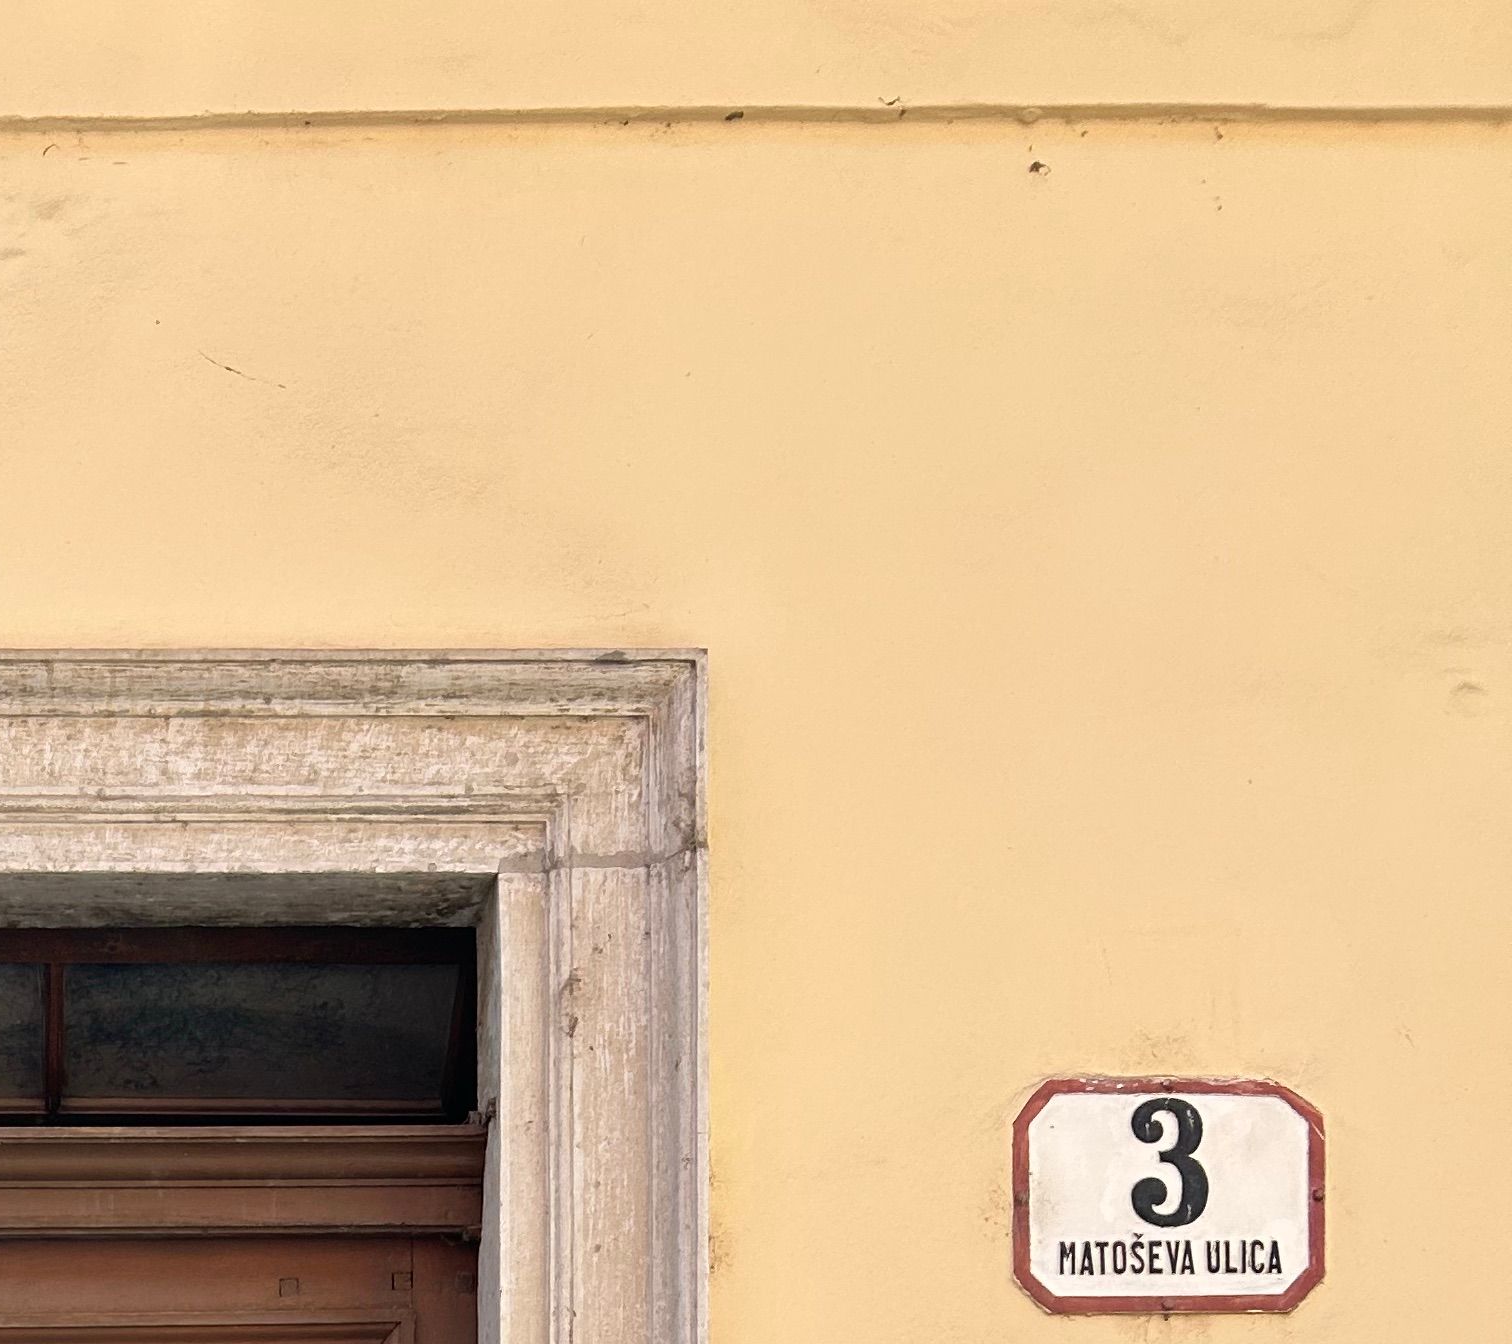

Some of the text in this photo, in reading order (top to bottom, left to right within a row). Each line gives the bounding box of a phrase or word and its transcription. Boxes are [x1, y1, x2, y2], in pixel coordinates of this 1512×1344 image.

[1131, 1097, 1209, 1228] 3
[1059, 1232, 1283, 1275] MATOŠEVA ULICA
